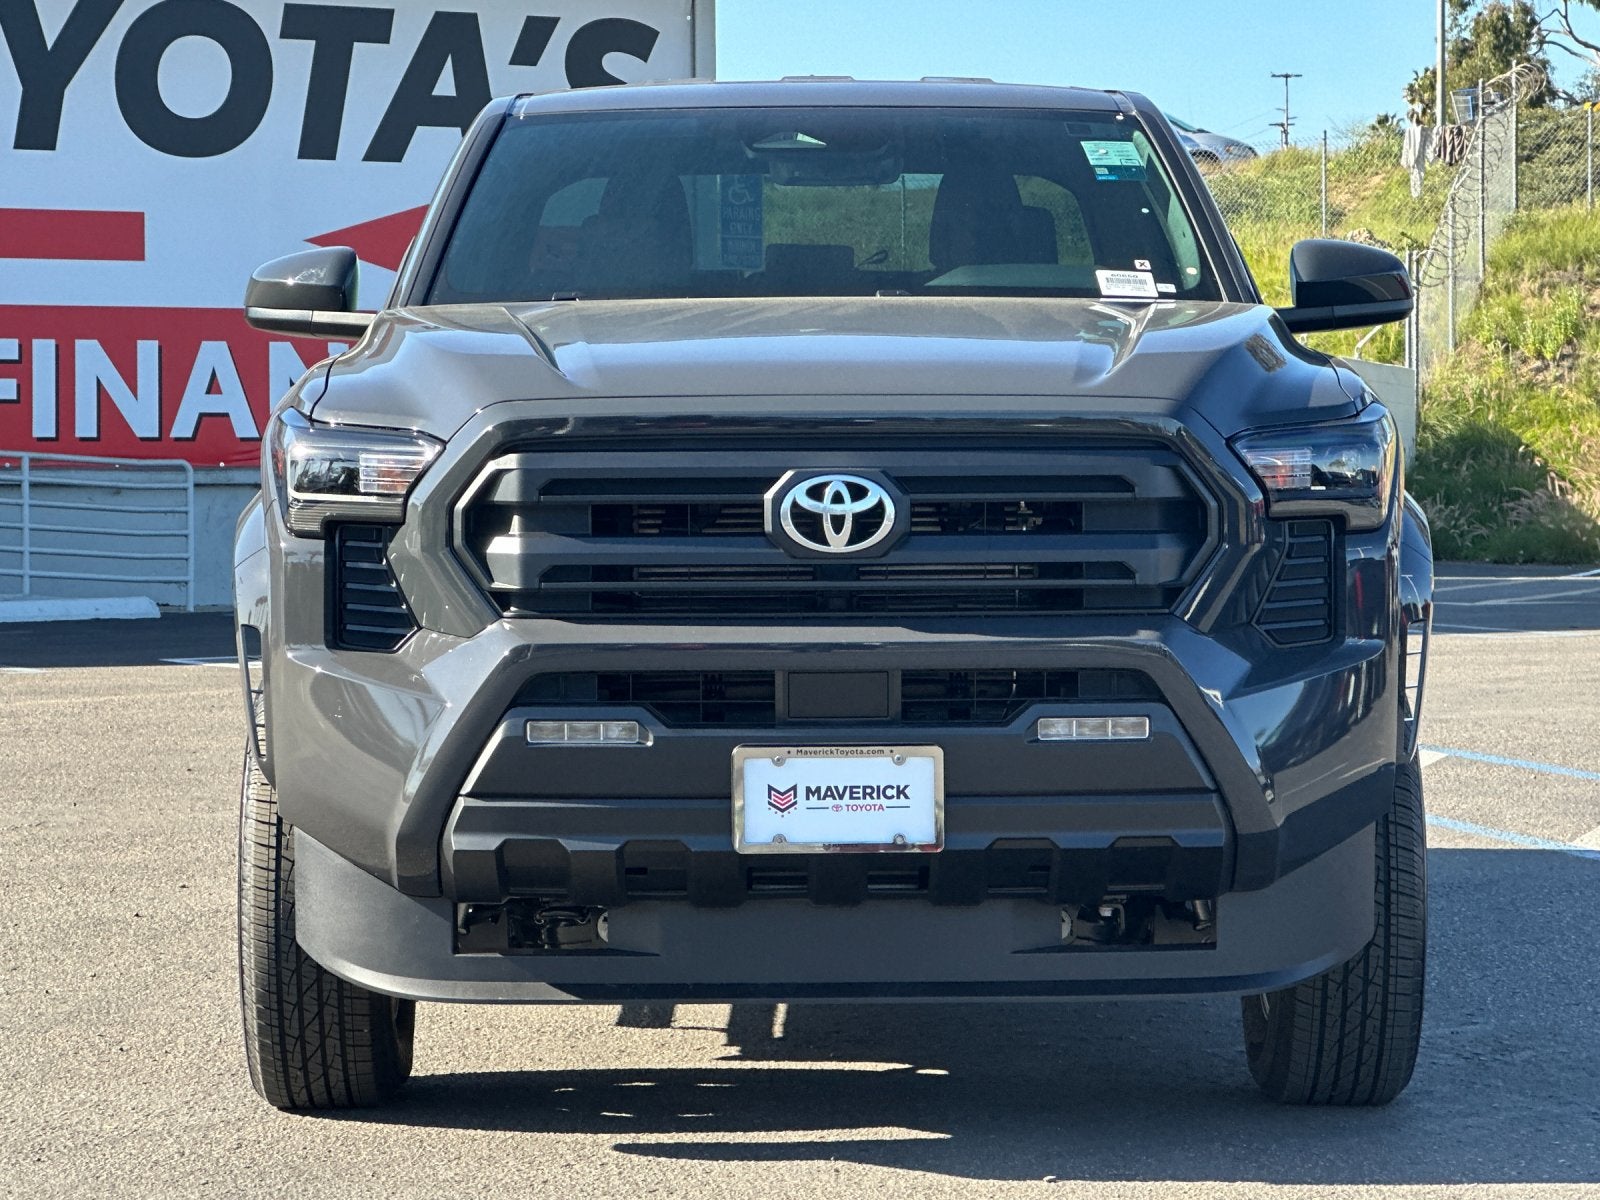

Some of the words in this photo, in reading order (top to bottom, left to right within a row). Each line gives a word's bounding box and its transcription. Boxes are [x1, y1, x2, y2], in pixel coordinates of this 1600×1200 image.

[796, 748, 885, 757] MaverickToyota.com
[805, 784, 911, 801] MAVERICK
[845, 803, 885, 812] TOYOTA
